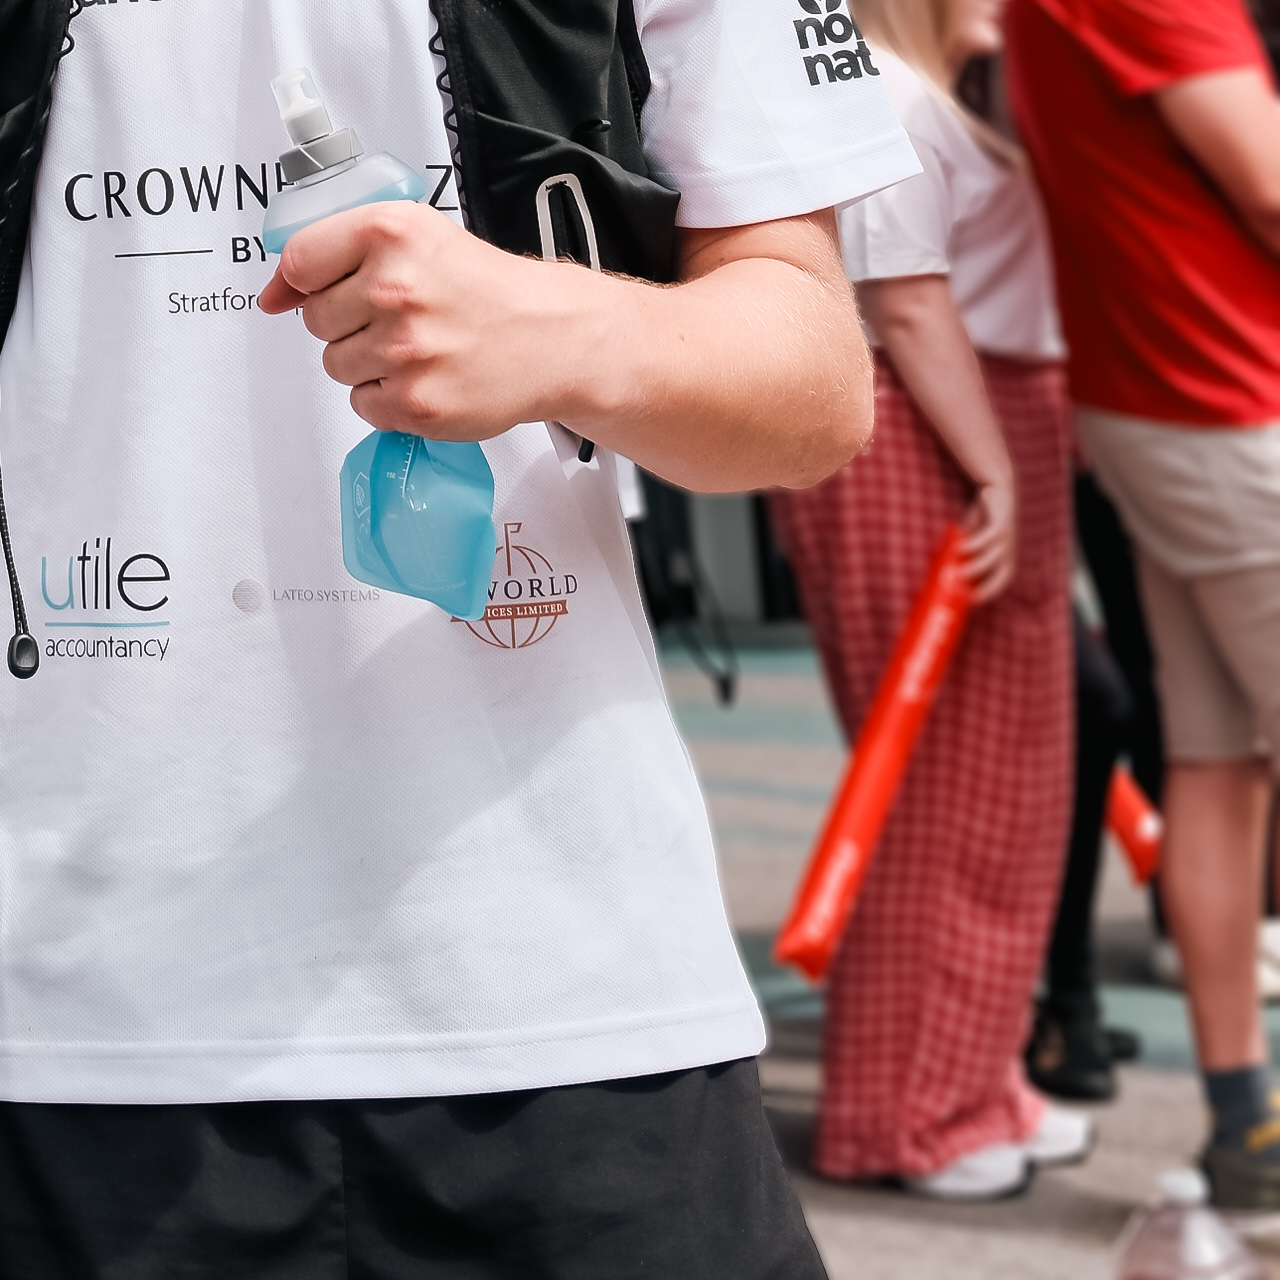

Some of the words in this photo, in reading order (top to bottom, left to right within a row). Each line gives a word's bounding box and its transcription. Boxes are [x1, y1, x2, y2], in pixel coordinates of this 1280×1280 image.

[41, 537, 171, 612] utile
[516, 603, 563, 615] LIMITED
[45, 635, 170, 661] accountancy
